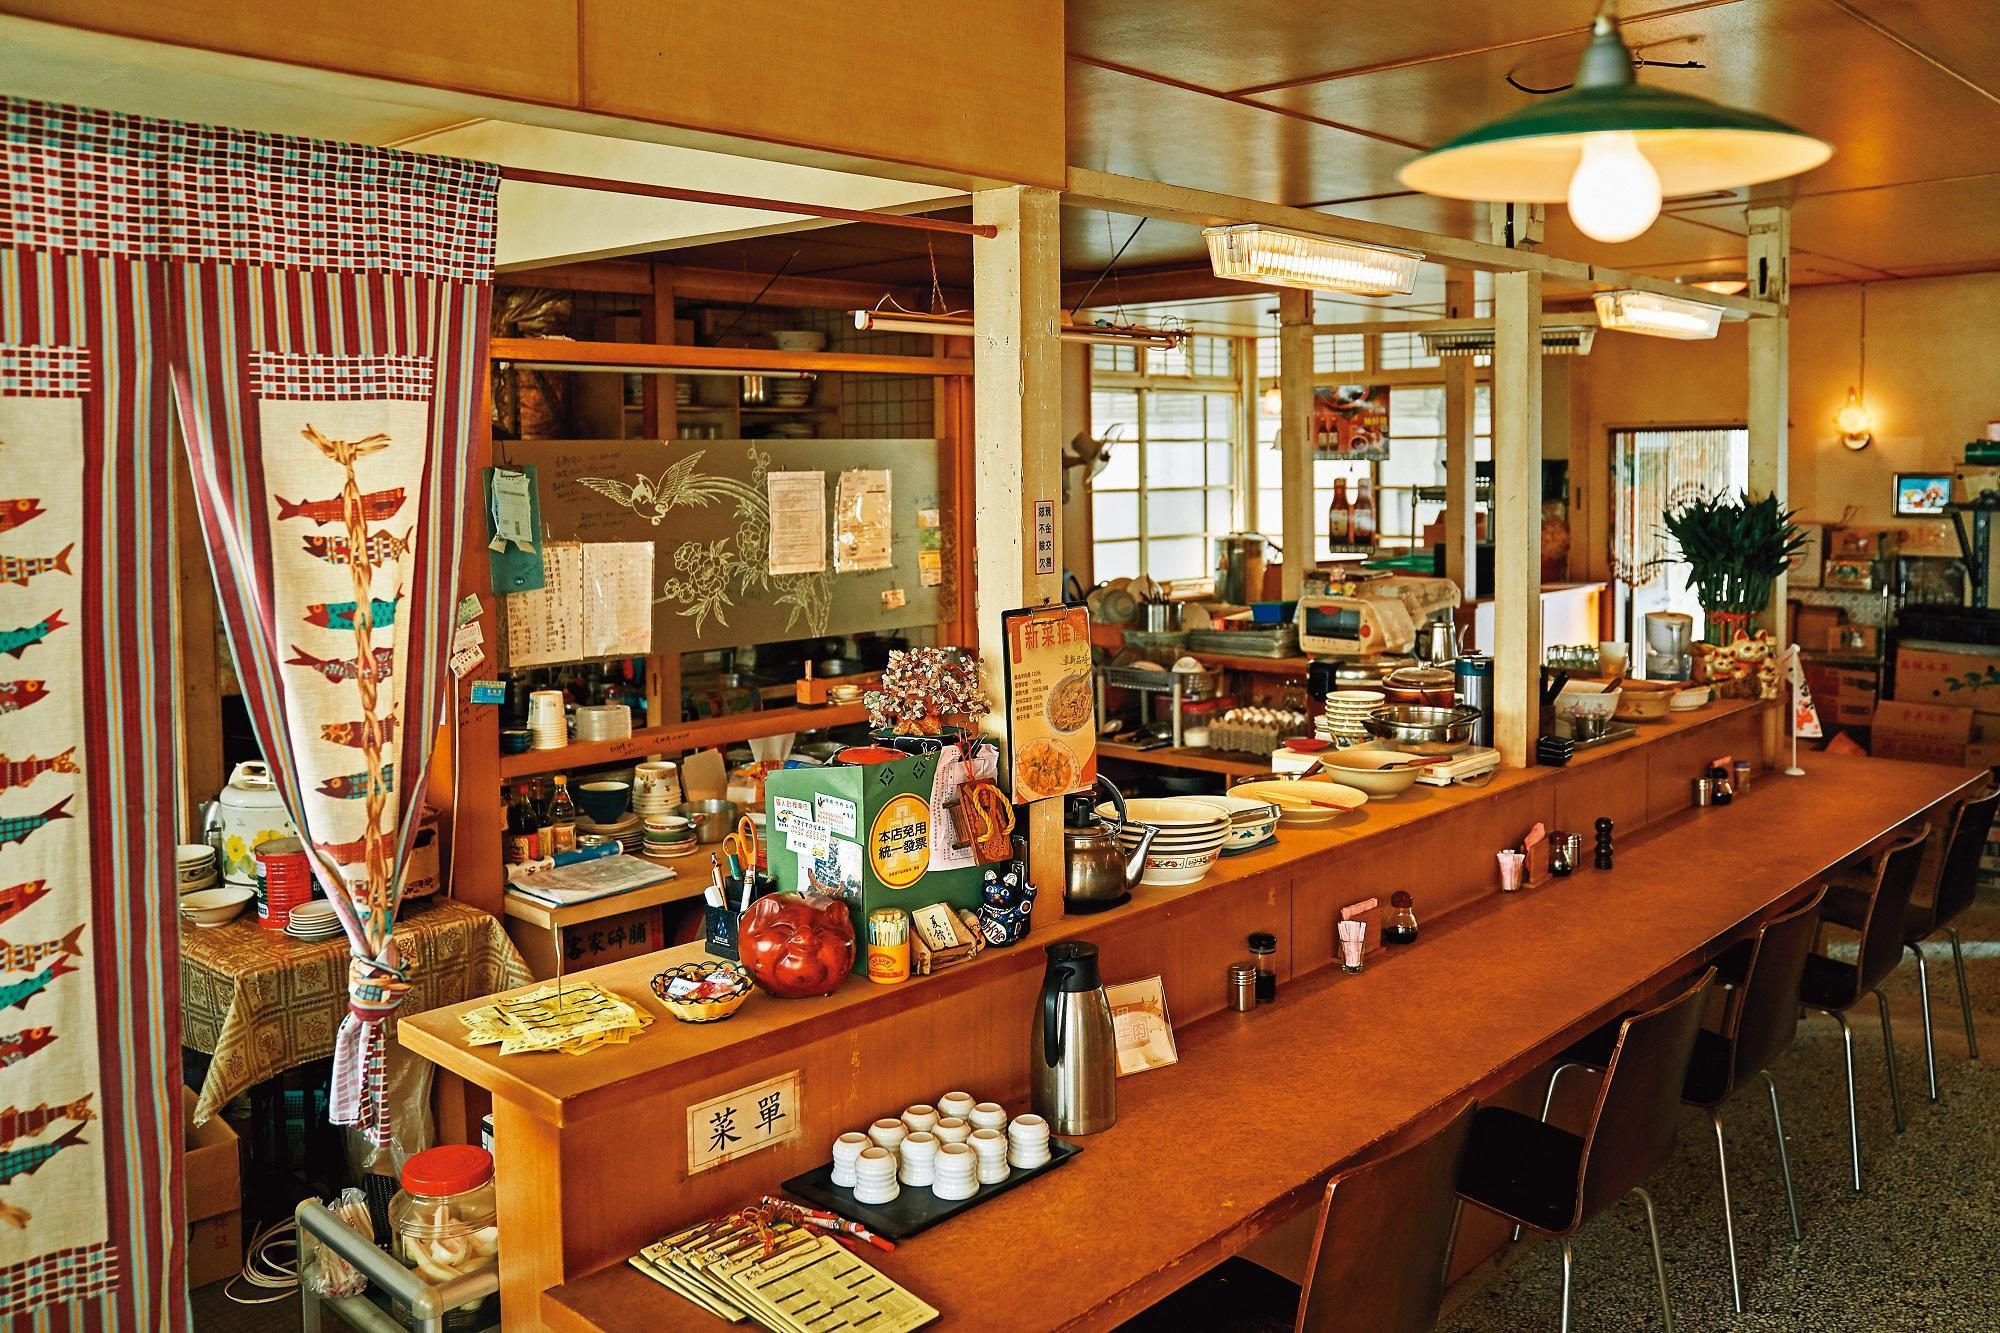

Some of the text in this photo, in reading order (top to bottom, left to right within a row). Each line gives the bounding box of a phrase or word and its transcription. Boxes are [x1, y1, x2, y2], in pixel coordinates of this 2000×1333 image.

[878, 821, 927, 843] 本店免用
[878, 836, 928, 860] 統一發票
[708, 1091, 787, 1153] 菜單
